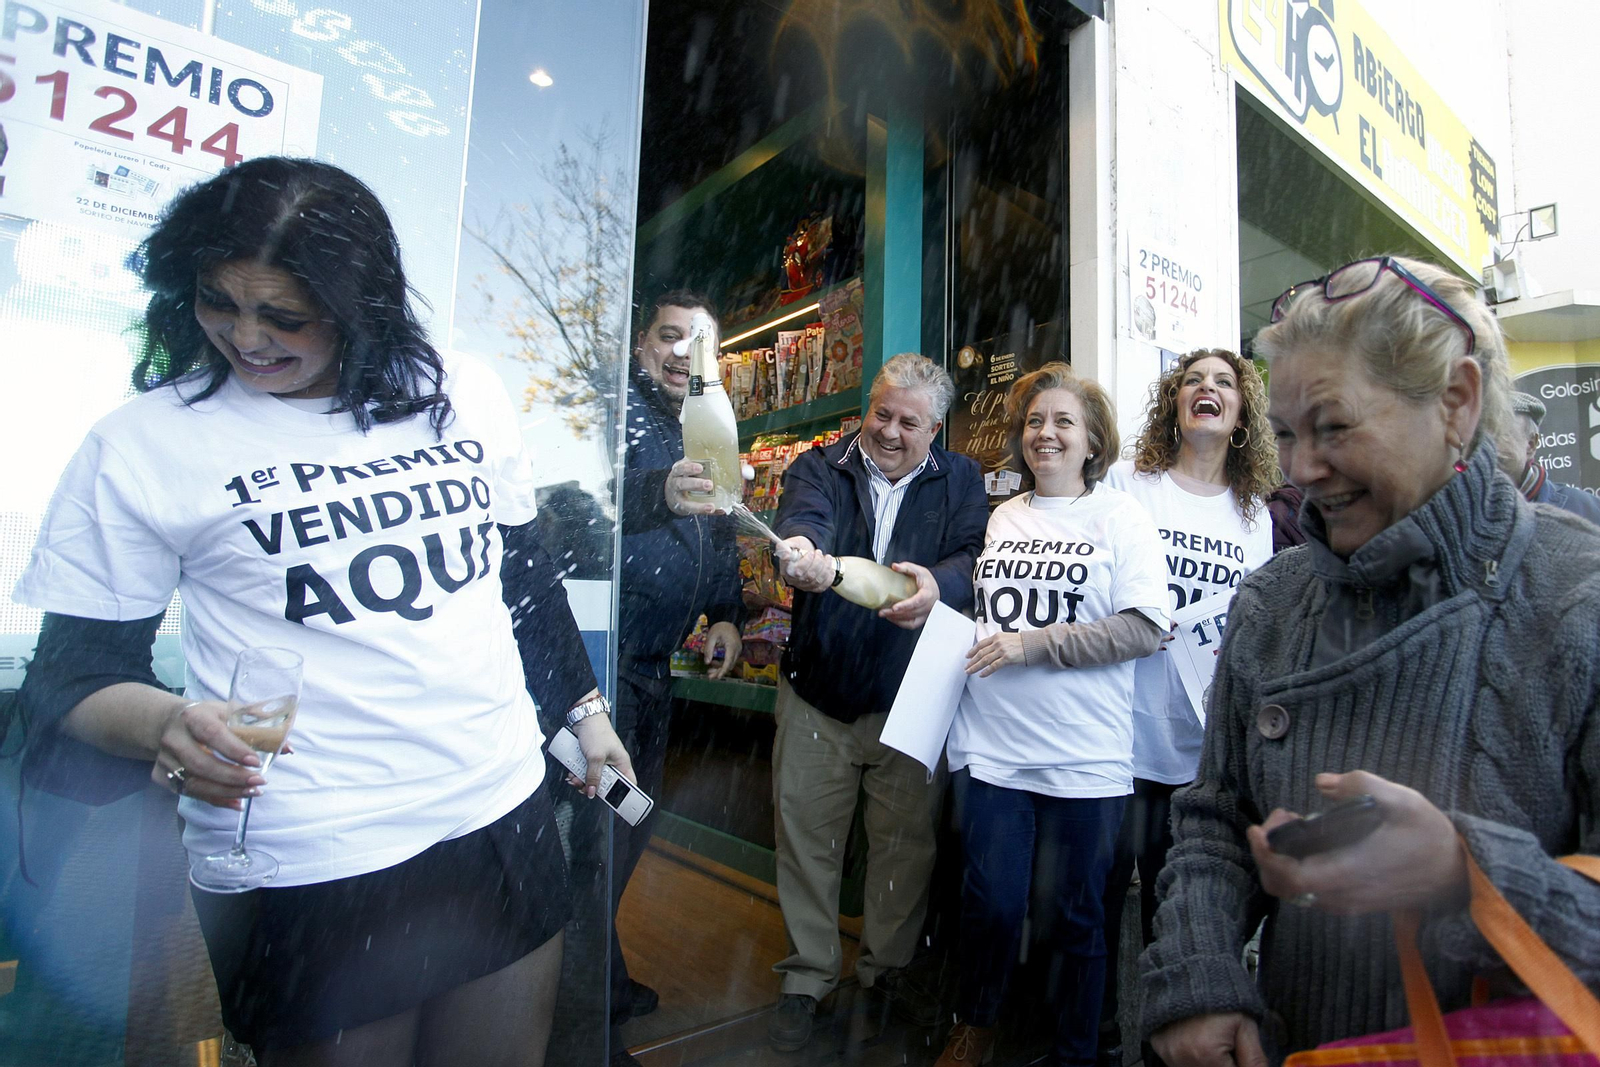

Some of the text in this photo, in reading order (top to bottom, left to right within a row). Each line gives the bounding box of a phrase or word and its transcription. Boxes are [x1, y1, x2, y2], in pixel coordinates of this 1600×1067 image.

[2, 0, 274, 118] PREMIO
[114, 152, 139, 163] Lucero
[1359, 114, 1382, 181] EL
[1476, 168, 1494, 200] LOW
[76, 197, 161, 222] 22 DE DICIEMBR
[79, 208, 113, 219] SORTEO
[1475, 192, 1497, 225] COST
[1151, 253, 1202, 292] PREMIO
[1146, 276, 1198, 317] 51244
[990, 354, 996, 363] 6
[990, 361, 1015, 373] SORTEO
[224, 440, 484, 508] 1er PREMIO
[1538, 454, 1572, 470] frías
[241, 476, 491, 556] VENDIDO
[996, 539, 1095, 557] PREMIO
[1158, 529, 1244, 563] PREMIO
[972, 559, 1088, 585] VENDIDO
[1165, 554, 1242, 588] NDIDO
